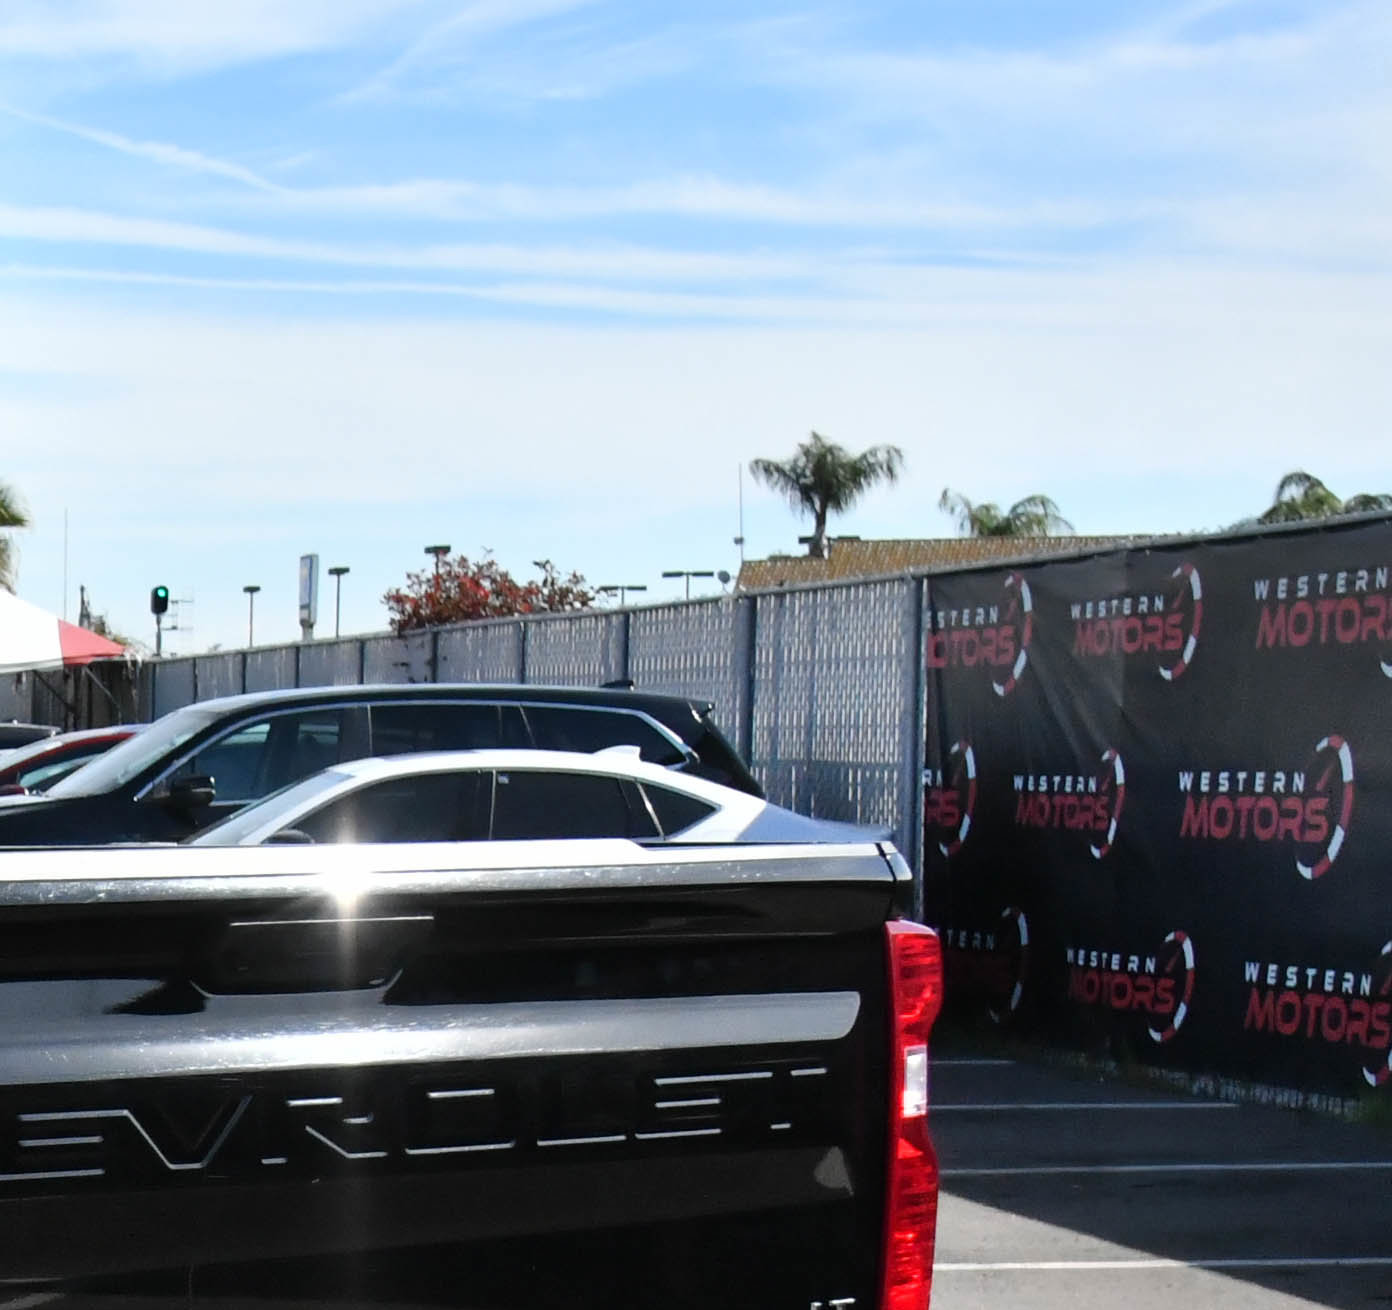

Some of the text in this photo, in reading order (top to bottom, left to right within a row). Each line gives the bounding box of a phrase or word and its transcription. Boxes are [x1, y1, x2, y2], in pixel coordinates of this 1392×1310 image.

[1254, 567, 1388, 601] WESTERN
[1071, 595, 1164, 621] WESTERN
[1256, 594, 1392, 650] MOTOR
[927, 625, 1015, 668] OTORS
[1073, 612, 1185, 657] MOTORS
[1013, 774, 1097, 793] WESTERN
[1178, 769, 1306, 794] WESTERN
[1016, 792, 1110, 831] MOTORS
[1179, 795, 1330, 843] MOTORS
[1066, 946, 1157, 975] WESTERN
[1244, 960, 1372, 998] WESTERN
[1069, 970, 1176, 1014] MOTORS
[1243, 986, 1391, 1050] MOTORS
